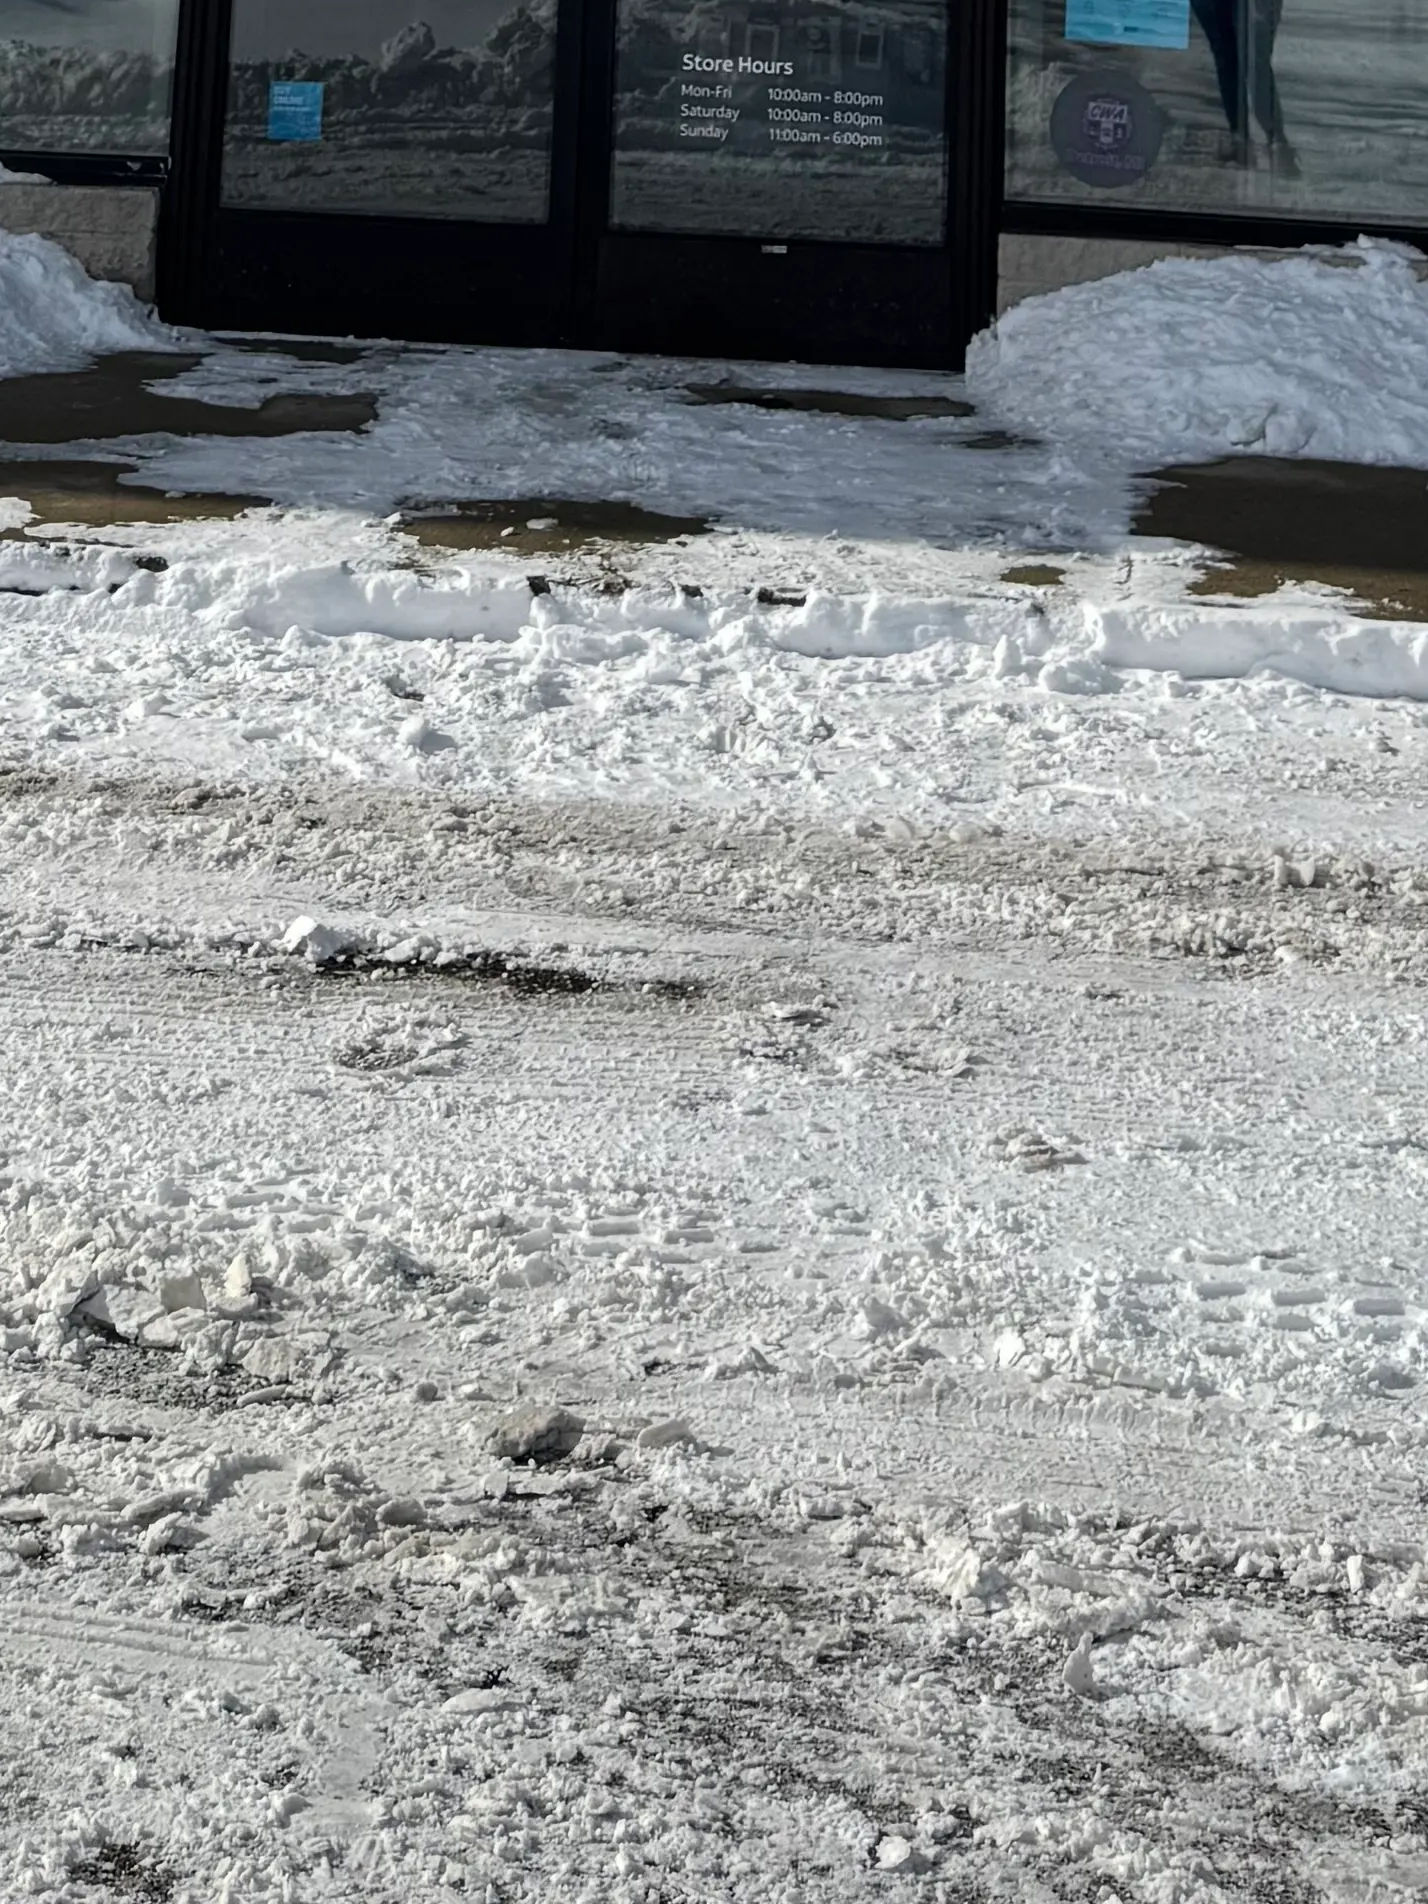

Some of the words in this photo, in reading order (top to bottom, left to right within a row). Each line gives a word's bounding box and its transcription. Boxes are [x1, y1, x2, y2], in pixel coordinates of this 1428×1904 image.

[682, 53, 734, 73] Store
[738, 56, 794, 75] Hours
[680, 83, 732, 98] Mon-Fri
[767, 88, 822, 103] 10:00am
[833, 91, 884, 108] 8:00pm
[680, 103, 741, 123] Saturday
[767, 108, 822, 123] 10:00am
[833, 111, 883, 128] 8:00pm
[679, 124, 729, 141] Sunday
[769, 128, 821, 143] 11:00am
[832, 132, 883, 148] 6:00pm
